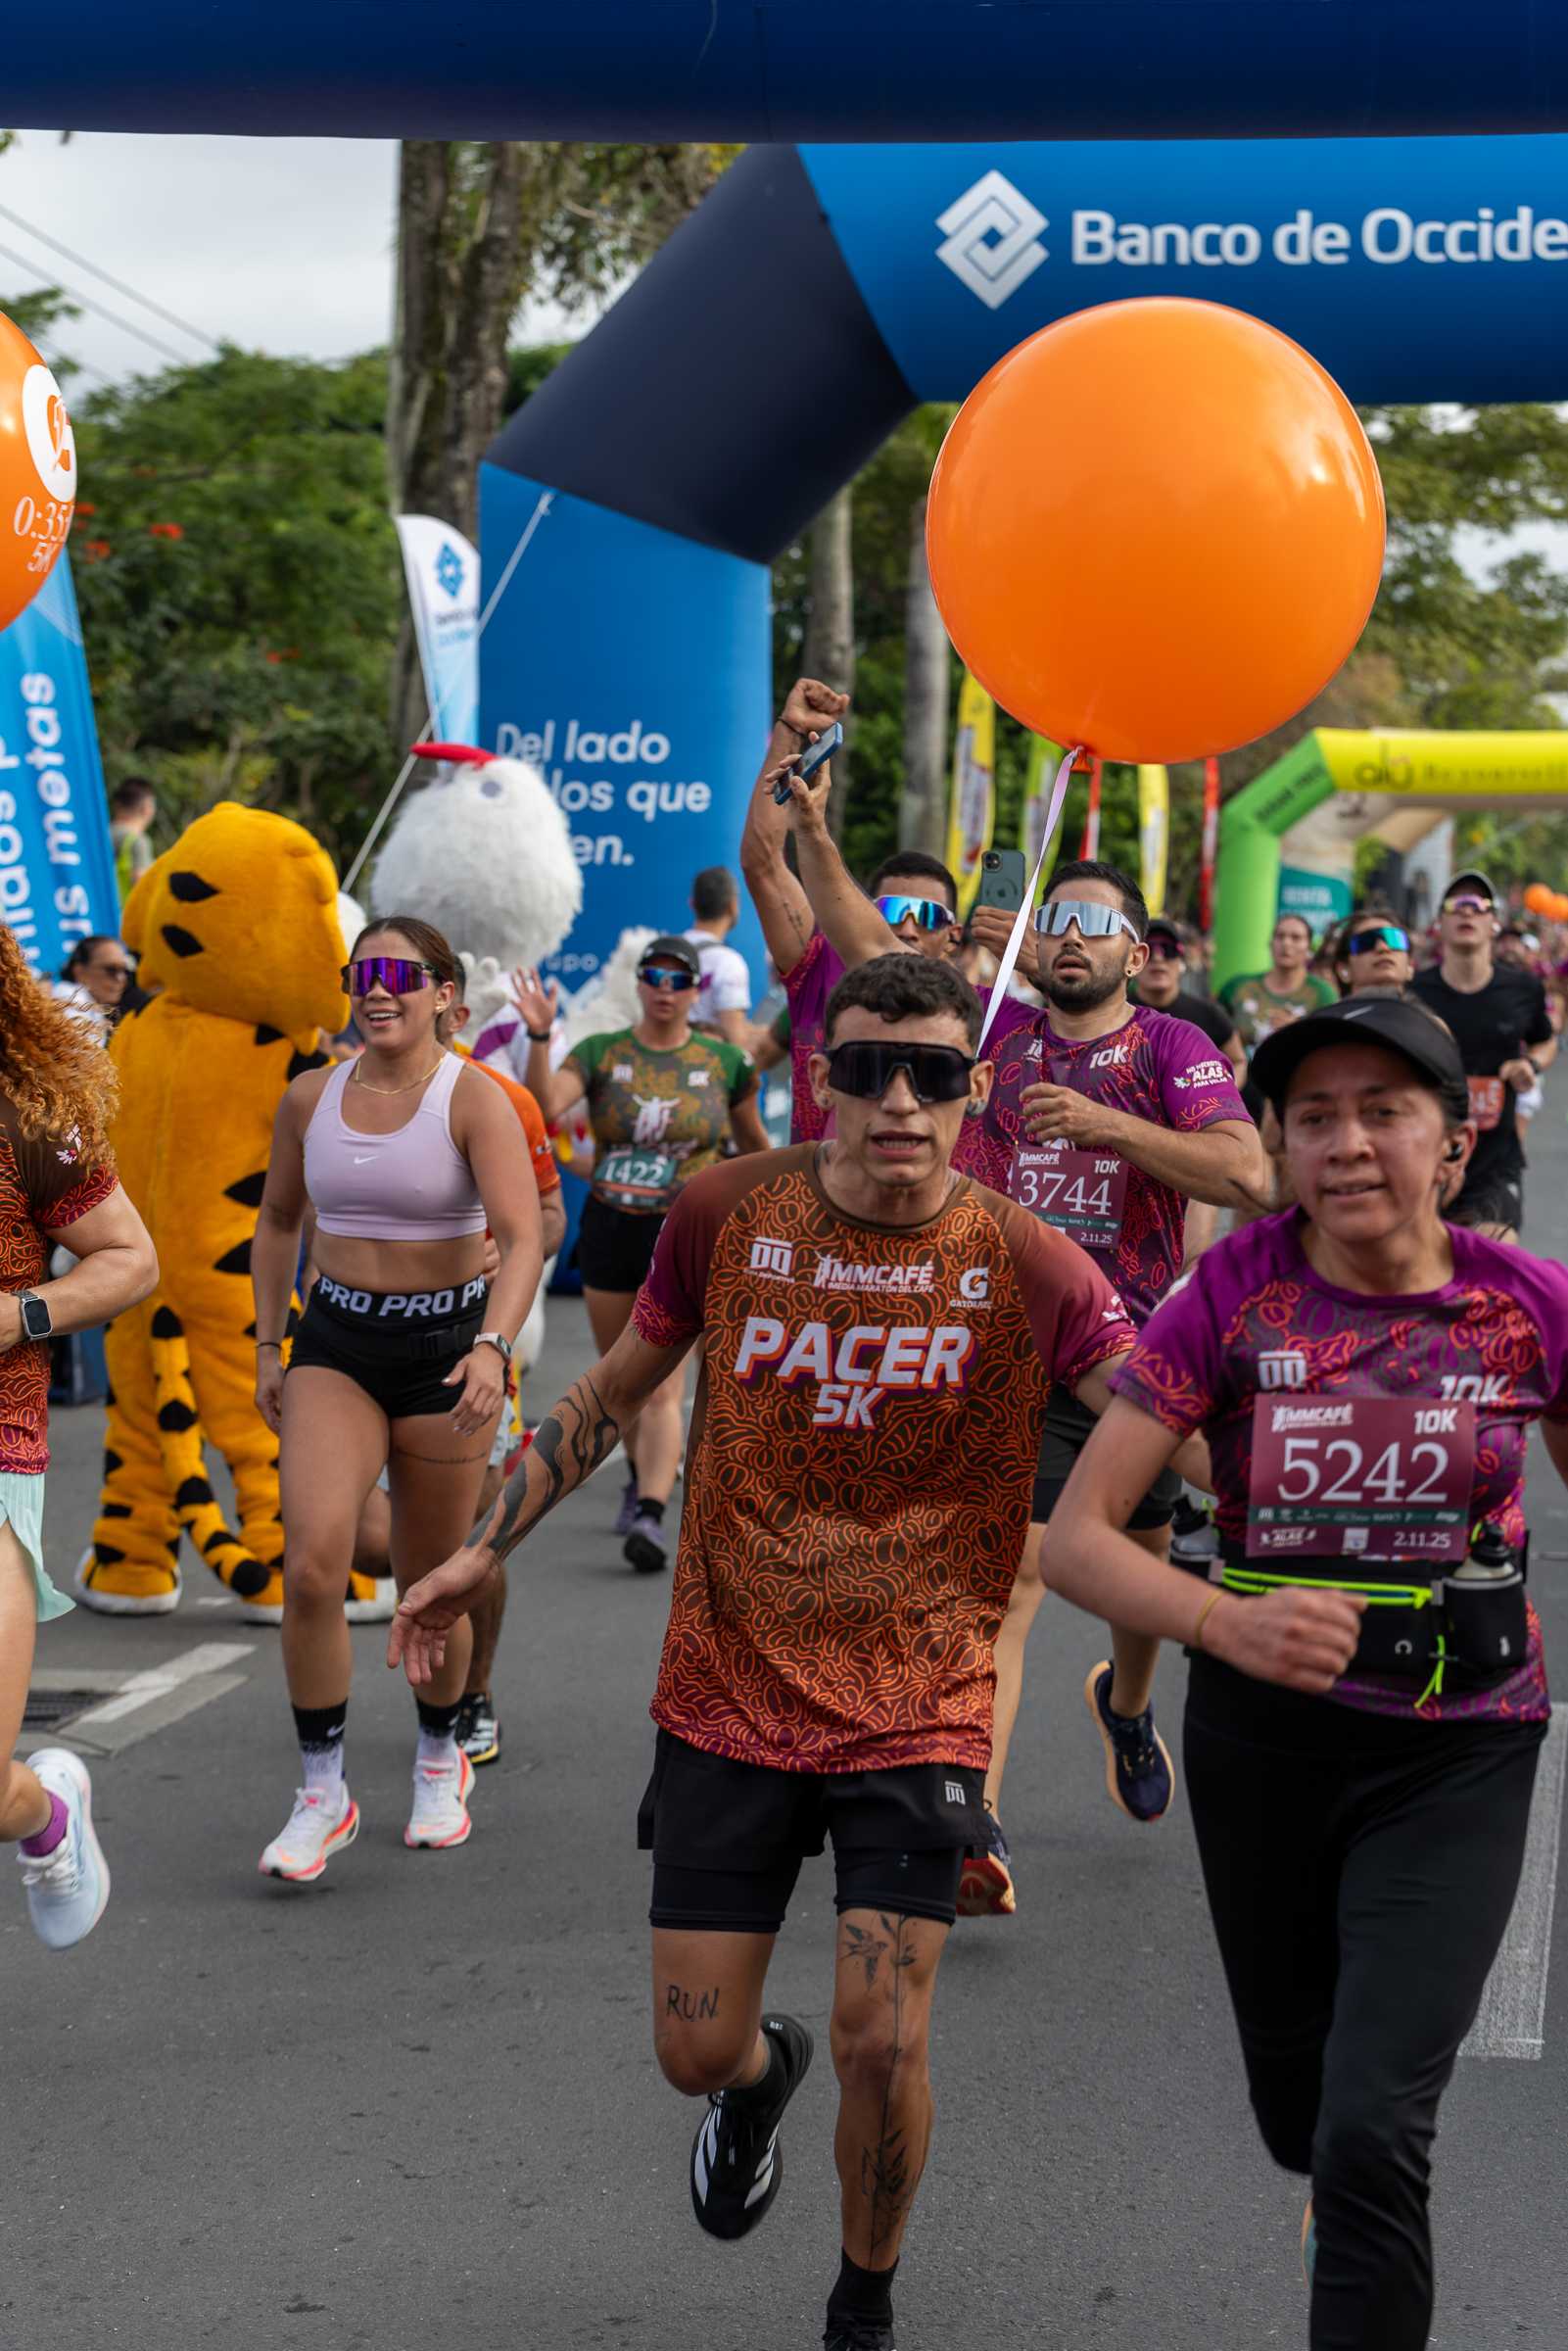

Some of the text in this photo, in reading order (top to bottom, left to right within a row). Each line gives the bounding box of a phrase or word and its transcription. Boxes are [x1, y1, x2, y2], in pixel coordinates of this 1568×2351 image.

[1071, 205, 1568, 266] Banco de Occide
[496, 719, 671, 764] Del lado
[21, 672, 80, 866] metas
[625, 781, 712, 823] que
[1089, 1044, 1128, 1069] 10K
[1193, 1066, 1223, 1082] ALAS
[603, 1160, 665, 1188] 1422
[1094, 1159, 1120, 1175] 10K
[1019, 1170, 1113, 1216] 3744
[1080, 1231, 1114, 1244] 2.11.25
[319, 1275, 372, 1315] PRO
[378, 1289, 455, 1318] PRO
[735, 1316, 974, 1387] PACER
[812, 1383, 886, 1429] 5K
[1440, 1373, 1511, 1404] 10K
[1413, 1408, 1458, 1434] 10K
[1277, 1437, 1449, 1504] 5242
[1393, 1531, 1452, 1550] 2.11.25
[665, 1984, 720, 2023] RUN
